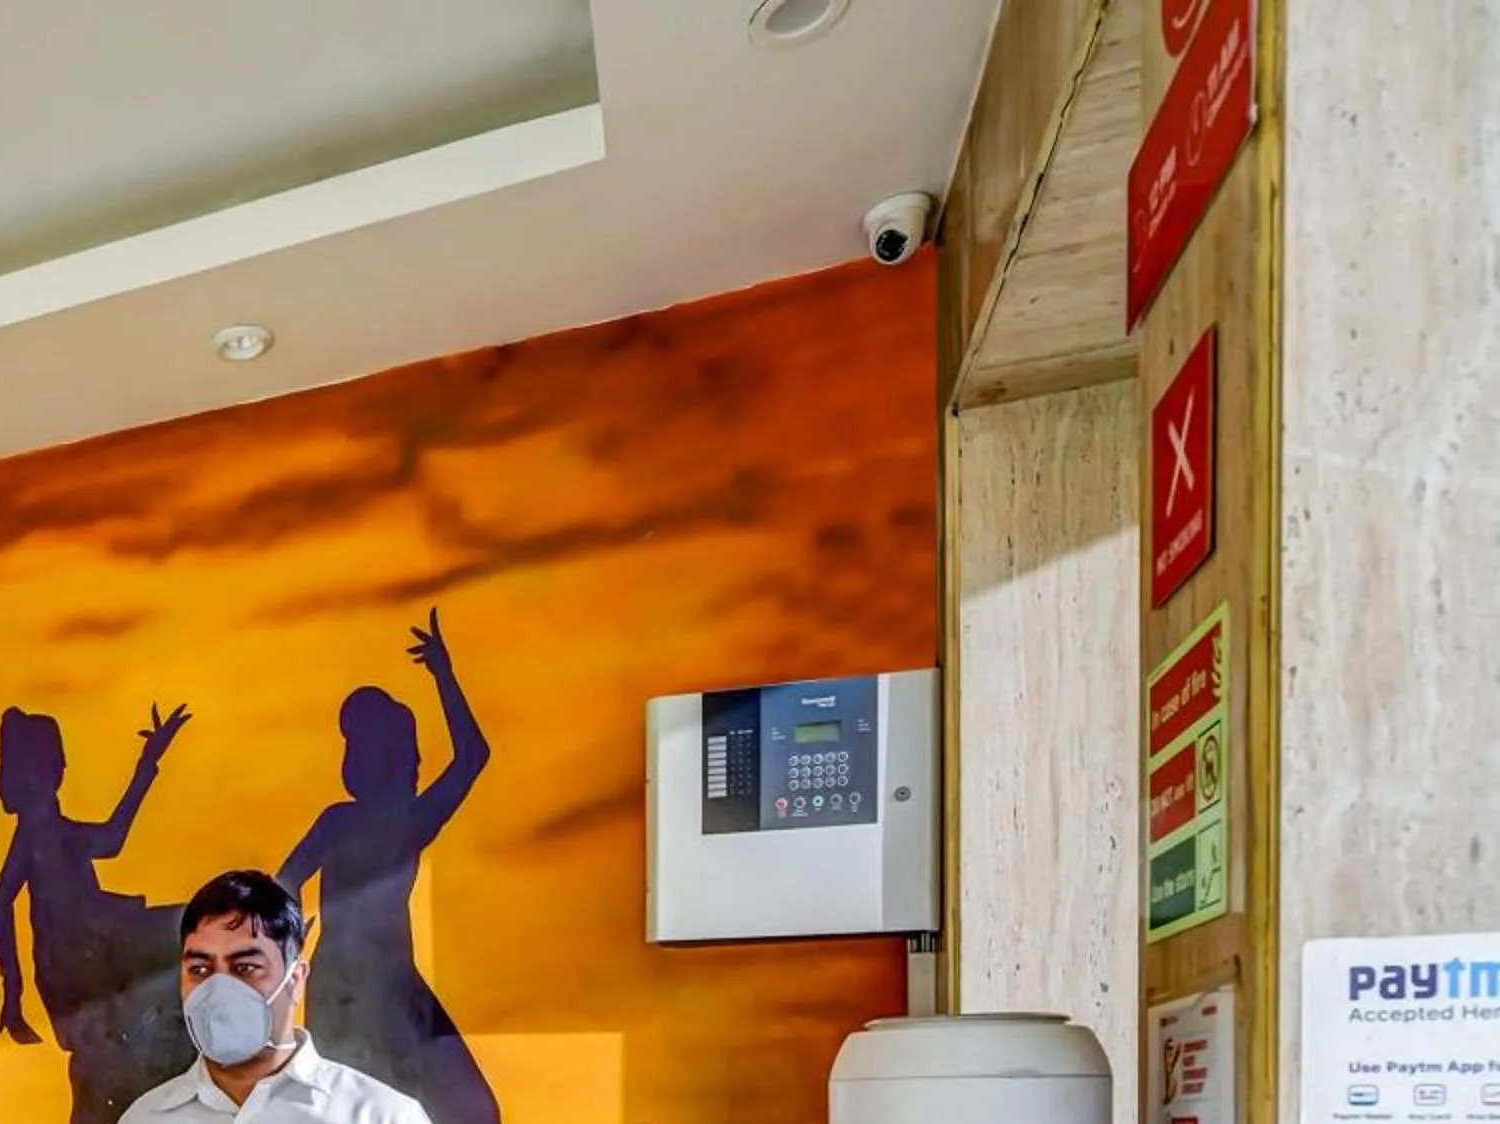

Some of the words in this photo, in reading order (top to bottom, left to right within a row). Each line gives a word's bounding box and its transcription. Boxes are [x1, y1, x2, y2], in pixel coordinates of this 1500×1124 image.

[1349, 1005, 1454, 1023] Accepted
[1349, 1061, 1382, 1073] Use
[1387, 1061, 1442, 1076] Paytm
[1448, 1060, 1484, 1075] App
